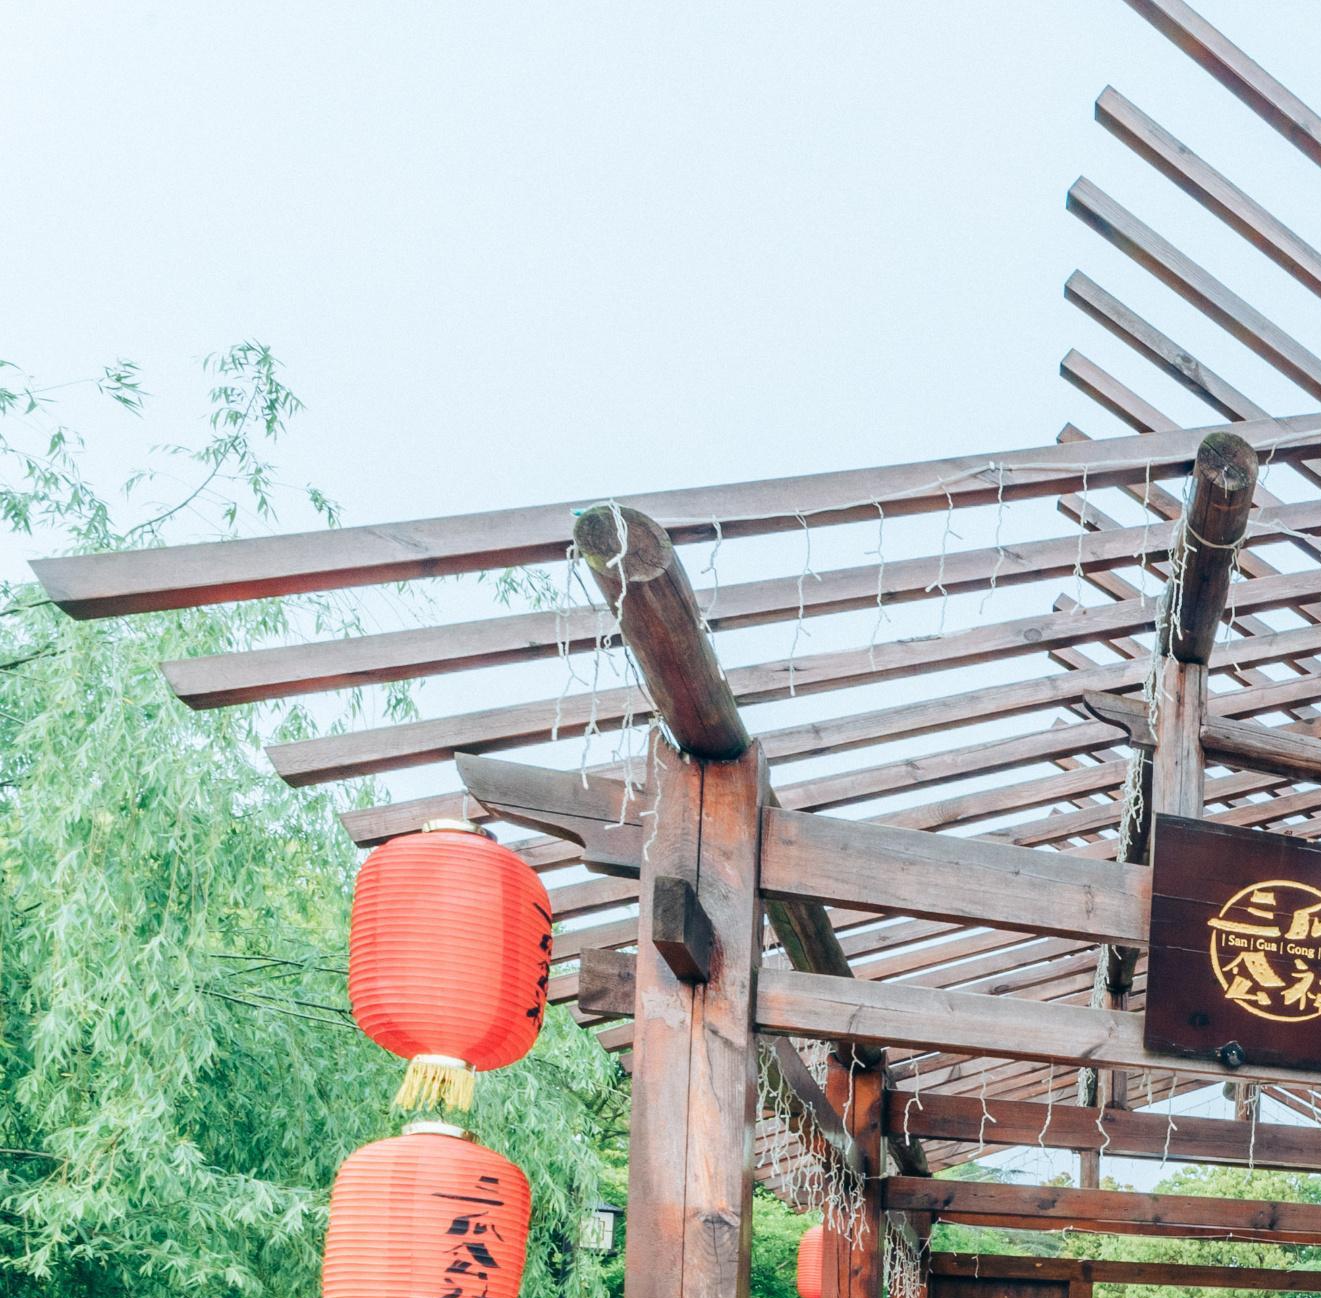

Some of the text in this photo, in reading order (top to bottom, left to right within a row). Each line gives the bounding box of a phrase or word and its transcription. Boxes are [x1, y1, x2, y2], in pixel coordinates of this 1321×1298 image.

[1228, 934, 1248, 948] San
[1256, 938, 1278, 952] Gua
[1286, 943, 1315, 959] Gong
